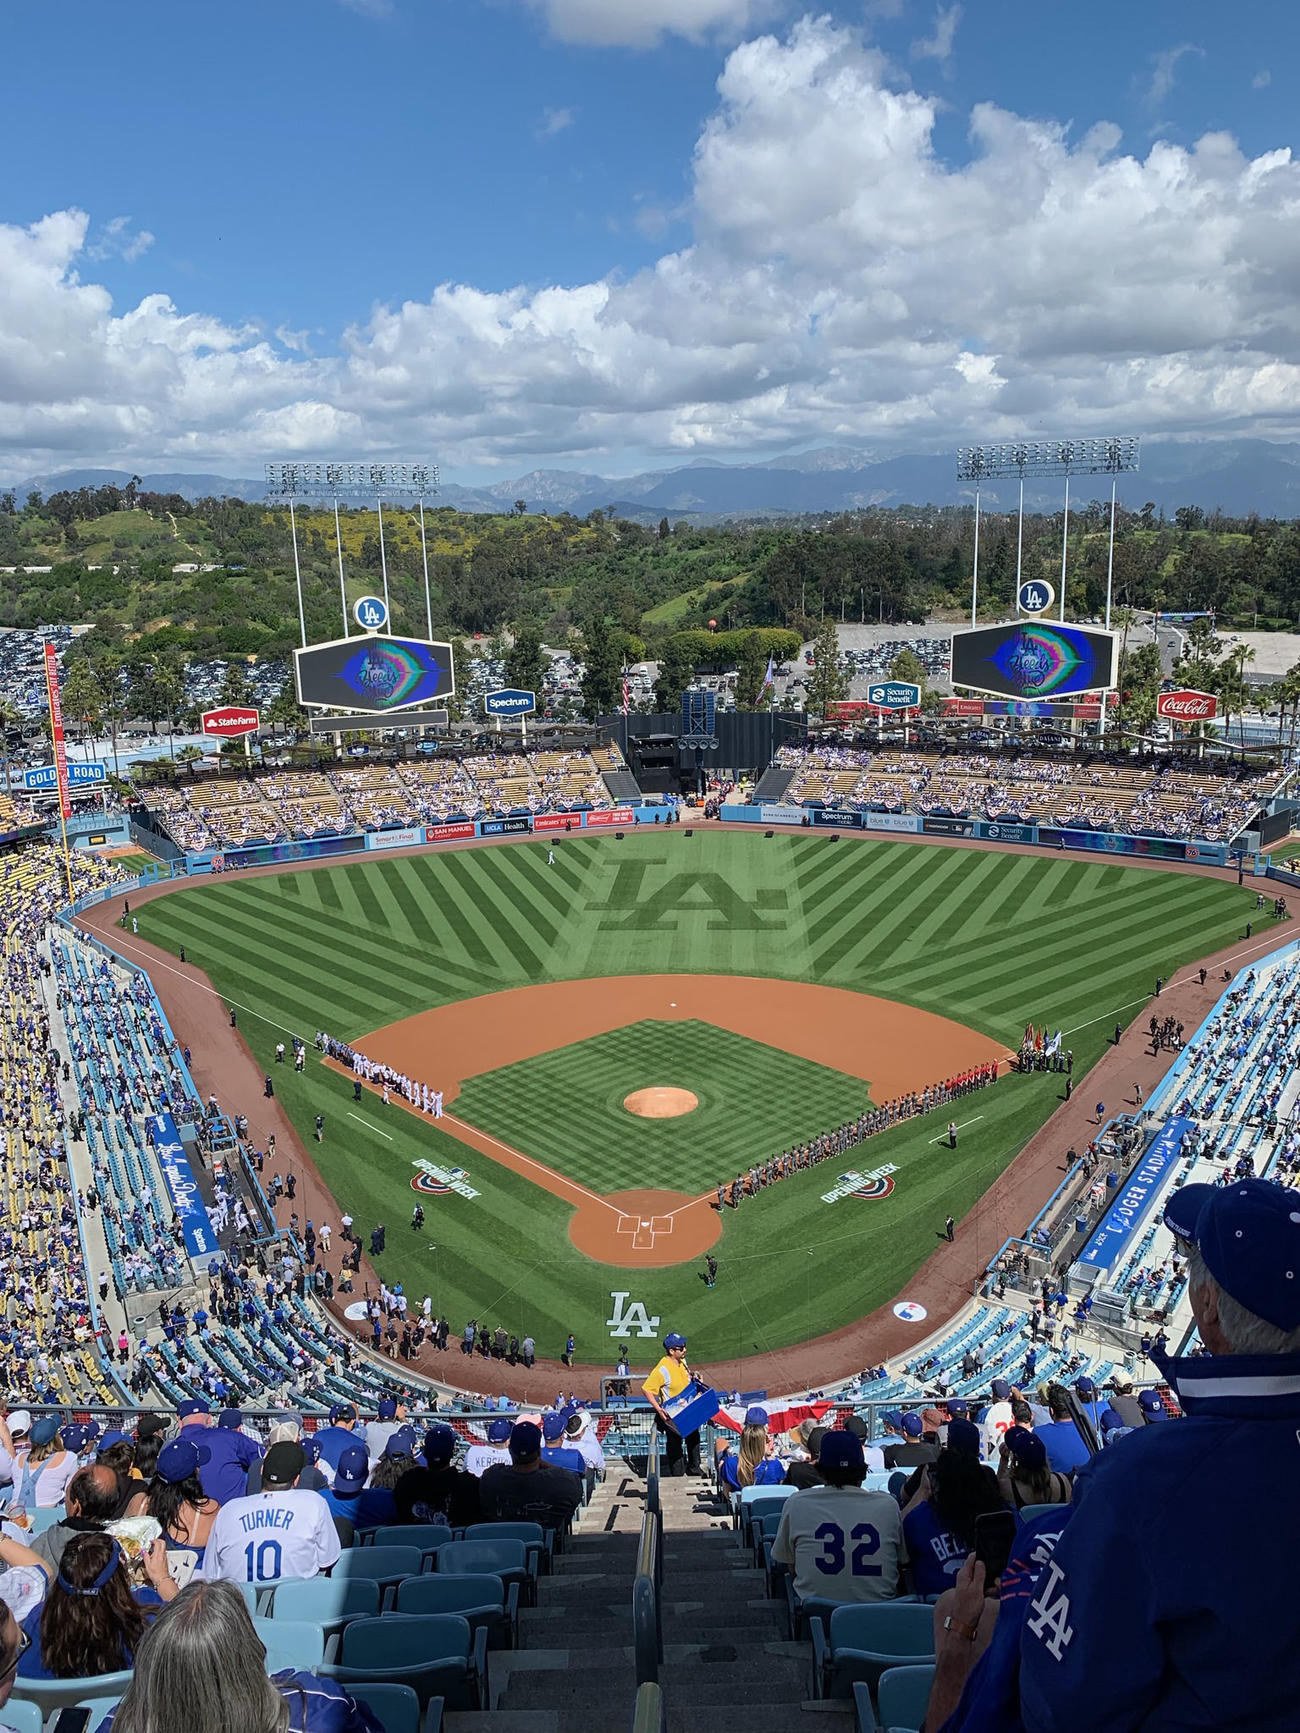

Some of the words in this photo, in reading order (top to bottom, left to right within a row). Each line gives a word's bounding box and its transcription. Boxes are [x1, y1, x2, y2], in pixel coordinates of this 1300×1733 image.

[1025, 585, 1043, 609] LA
[363, 602, 382, 624] LA
[886, 688, 915, 697] Security
[489, 698, 529, 709] Spectrum
[886, 696, 912, 704] Benefit
[1161, 697, 1211, 715] Coca-Cola
[217, 717, 238, 727] State
[238, 716, 257, 725] Farm
[74, 766, 102, 779] ROAD
[535, 818, 560, 827] Emirates
[821, 812, 852, 821] Spectrum
[870, 817, 884, 825] blue
[434, 827, 448, 835] SAN
[448, 825, 473, 834] MANUEL
[504, 822, 525, 831] Health
[1001, 826, 1024, 836] Security
[375, 835, 395, 843] Smart
[399, 832, 414, 840] Final
[1001, 832, 1020, 840] Benefit
[1188, 848, 1197, 856] 76
[584, 858, 789, 931] LA
[411, 1158, 457, 1184] OPENING
[447, 1179, 483, 1200] WEEK
[820, 1176, 872, 1204] OPENING
[864, 1162, 901, 1181] WEEK
[191, 1226, 208, 1253] Spectrum
[606, 1291, 660, 1338] LA
[239, 1508, 294, 1533] TURNER
[814, 1522, 883, 1577] 32
[244, 1539, 282, 1582] 10
[1026, 1559, 1074, 1662] LA
